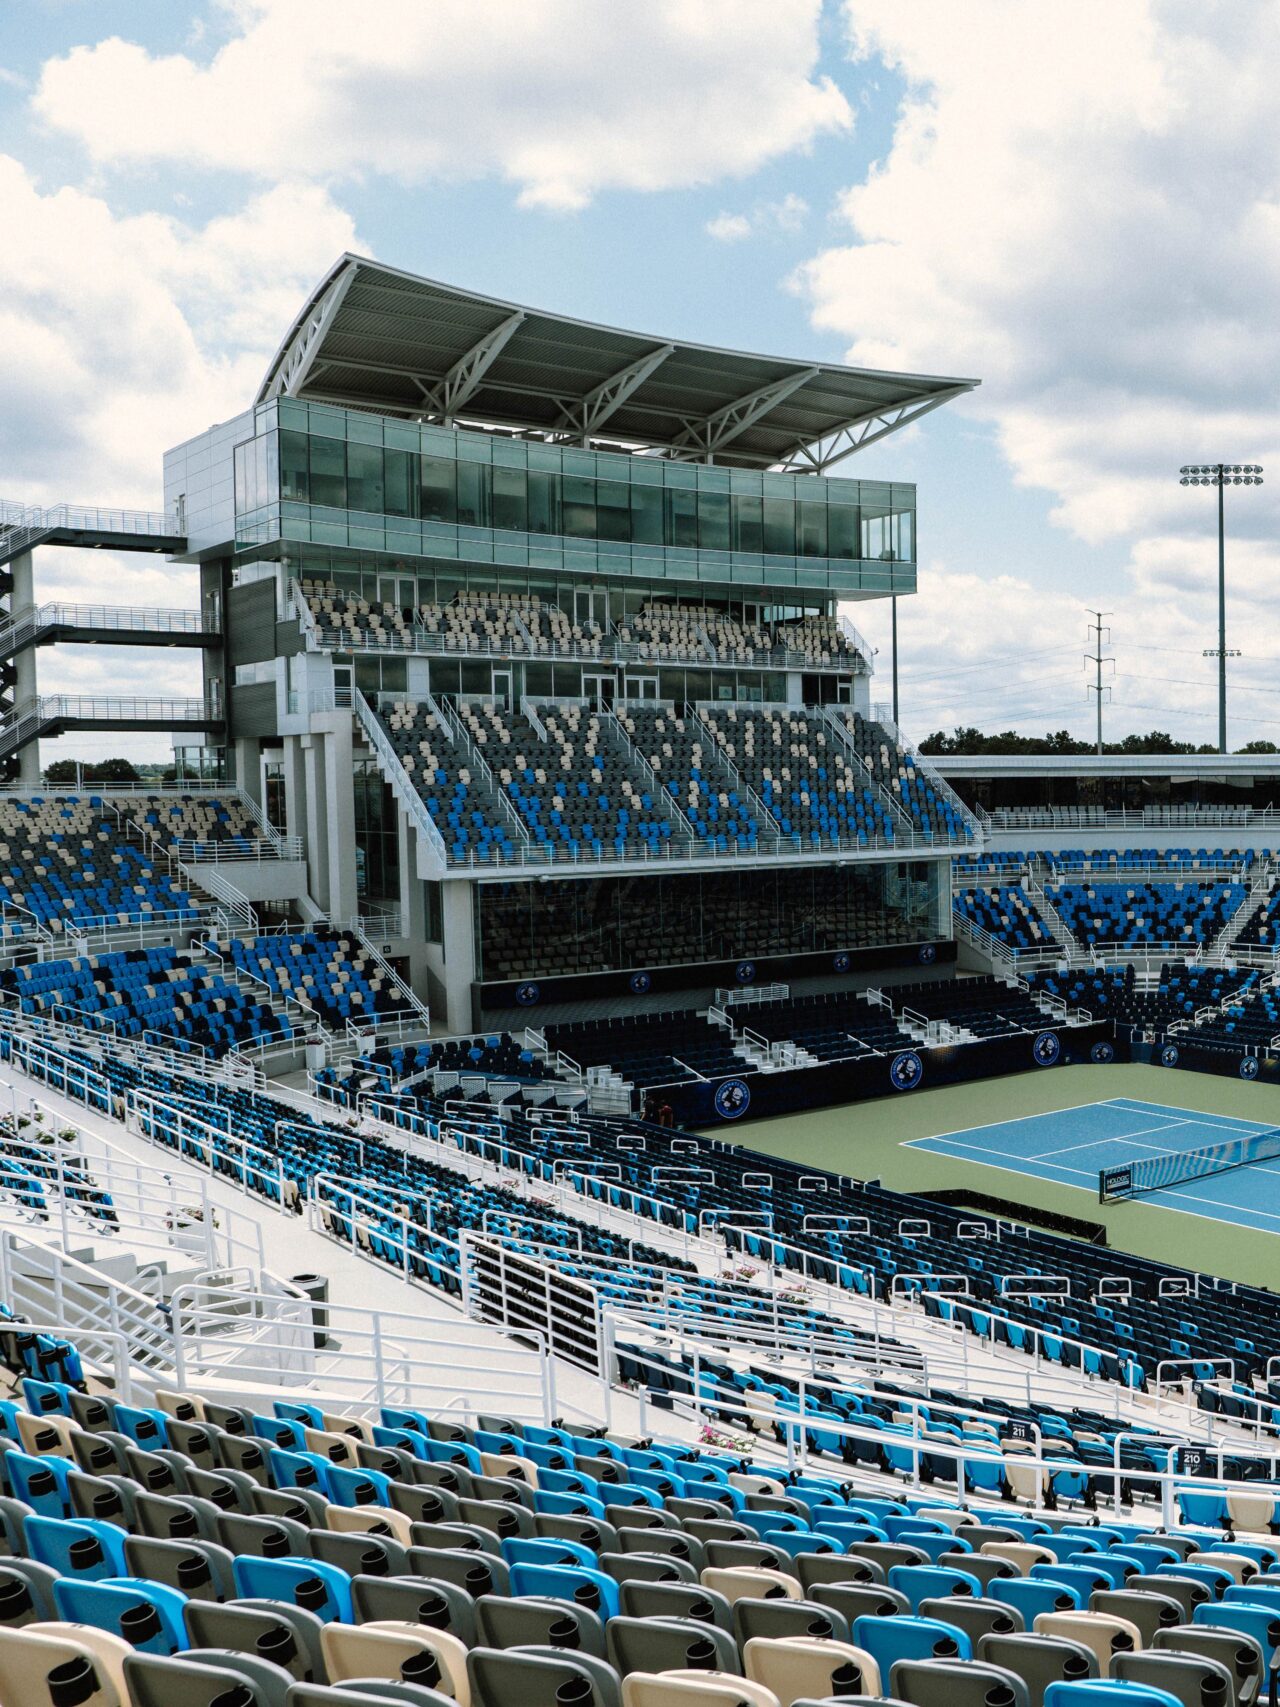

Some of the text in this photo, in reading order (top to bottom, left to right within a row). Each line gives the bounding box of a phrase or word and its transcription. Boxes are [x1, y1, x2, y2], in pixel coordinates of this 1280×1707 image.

[1106, 1174, 1130, 1185] HOLOGIC
[1013, 1427, 1025, 1437] 211
[1184, 1454, 1200, 1464] 210
